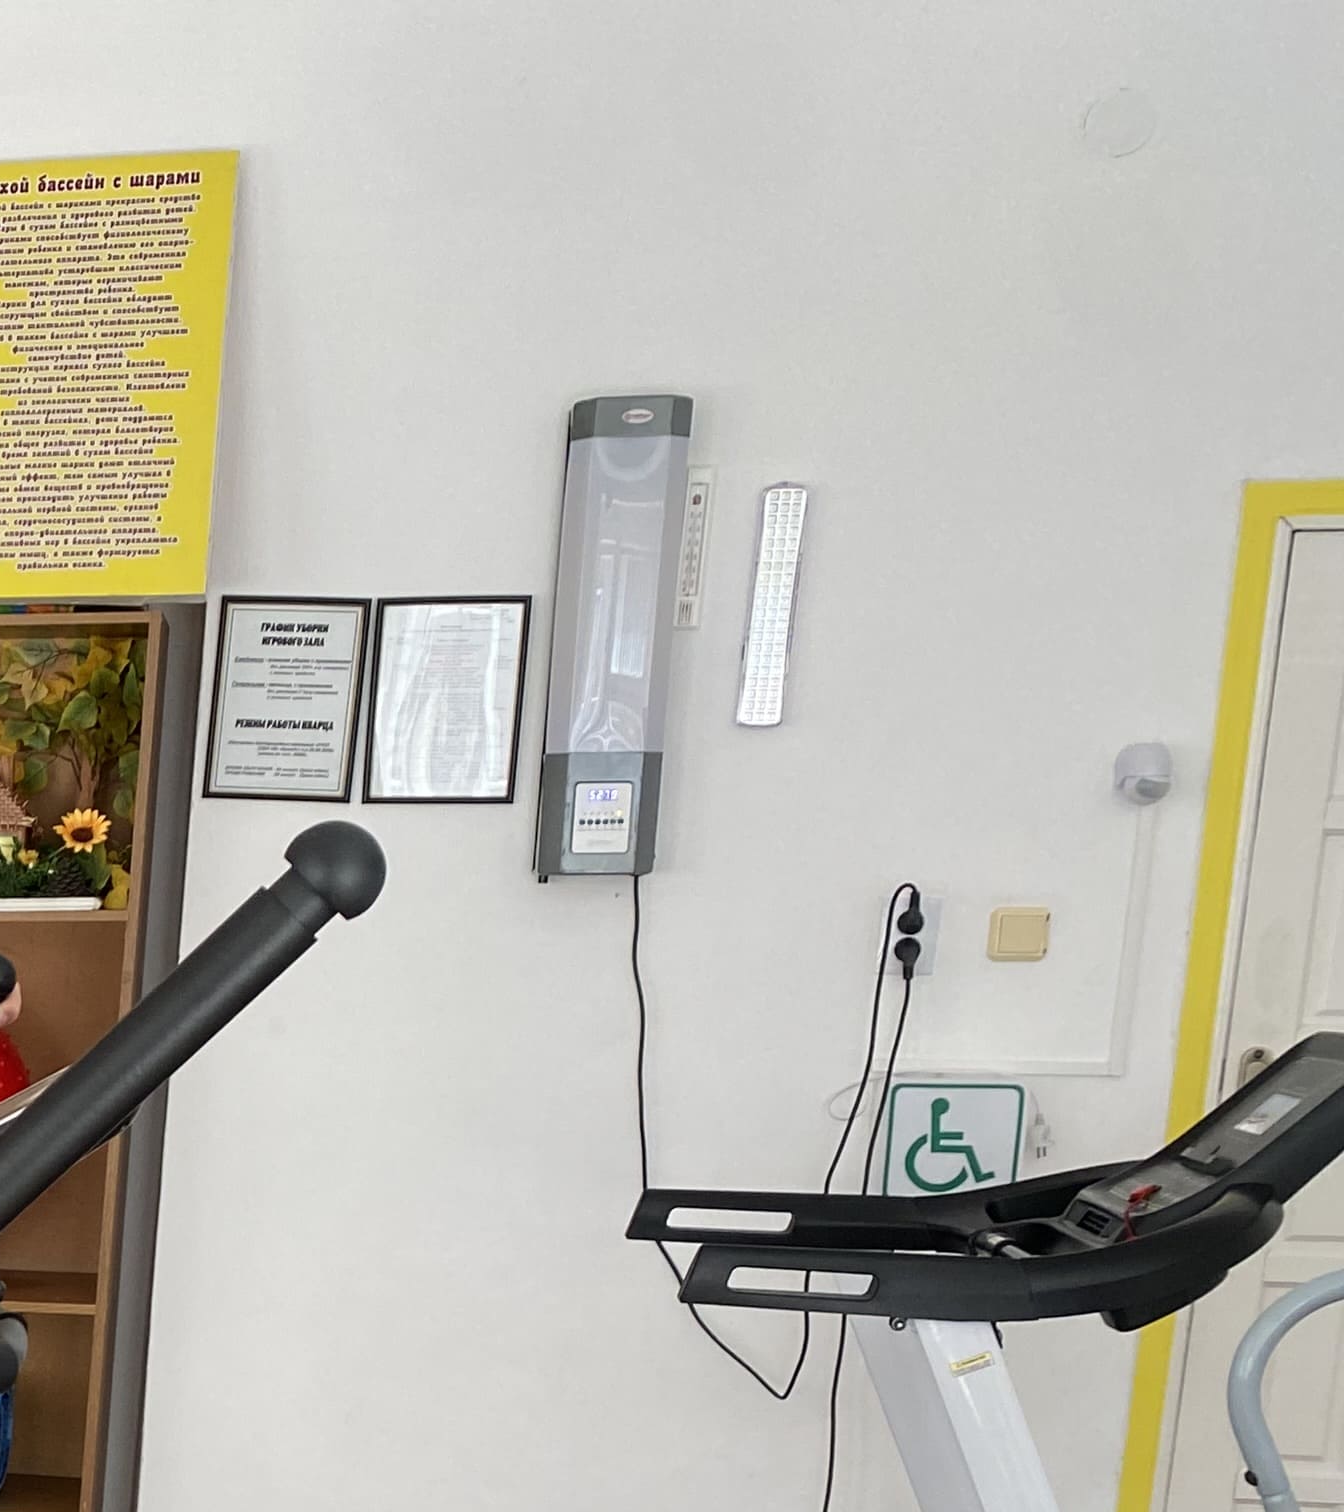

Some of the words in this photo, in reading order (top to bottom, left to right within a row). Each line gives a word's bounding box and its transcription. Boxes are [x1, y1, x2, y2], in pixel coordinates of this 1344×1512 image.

[38, 173, 105, 193] бассейн
[113, 176, 122, 189] с
[129, 171, 200, 190] шарами
